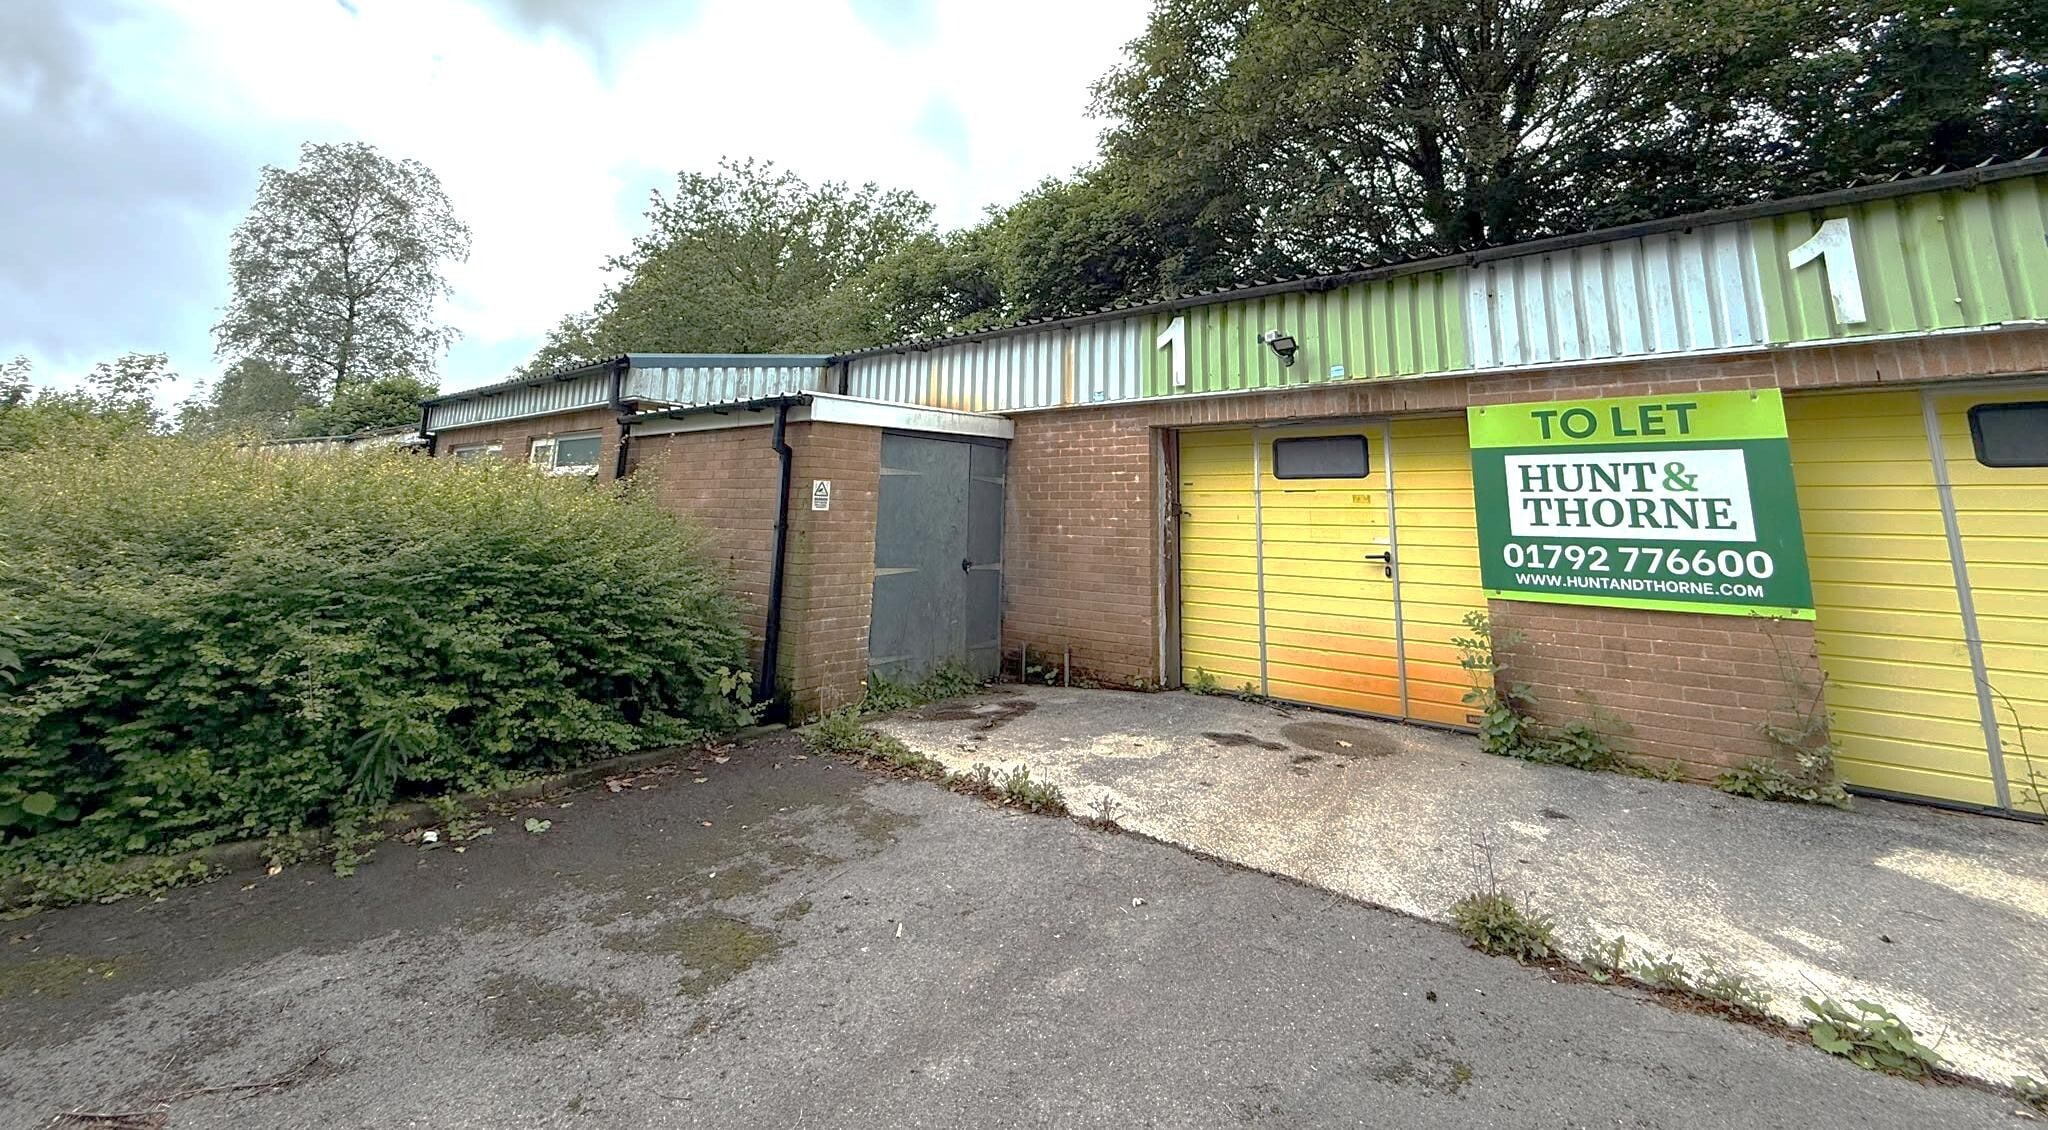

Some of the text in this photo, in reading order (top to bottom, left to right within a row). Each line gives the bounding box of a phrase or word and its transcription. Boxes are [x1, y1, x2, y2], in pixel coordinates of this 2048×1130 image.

[1788, 218, 1866, 325] 1
[1157, 316, 1185, 387] 1
[1531, 402, 1697, 440] TO LET
[1518, 461, 1698, 493] HUNT &
[1522, 497, 1737, 530] THORNE
[1503, 543, 1774, 579] 01792 776600
[1516, 573, 1764, 598] WWW.HUNTANDTHORNE.COM
